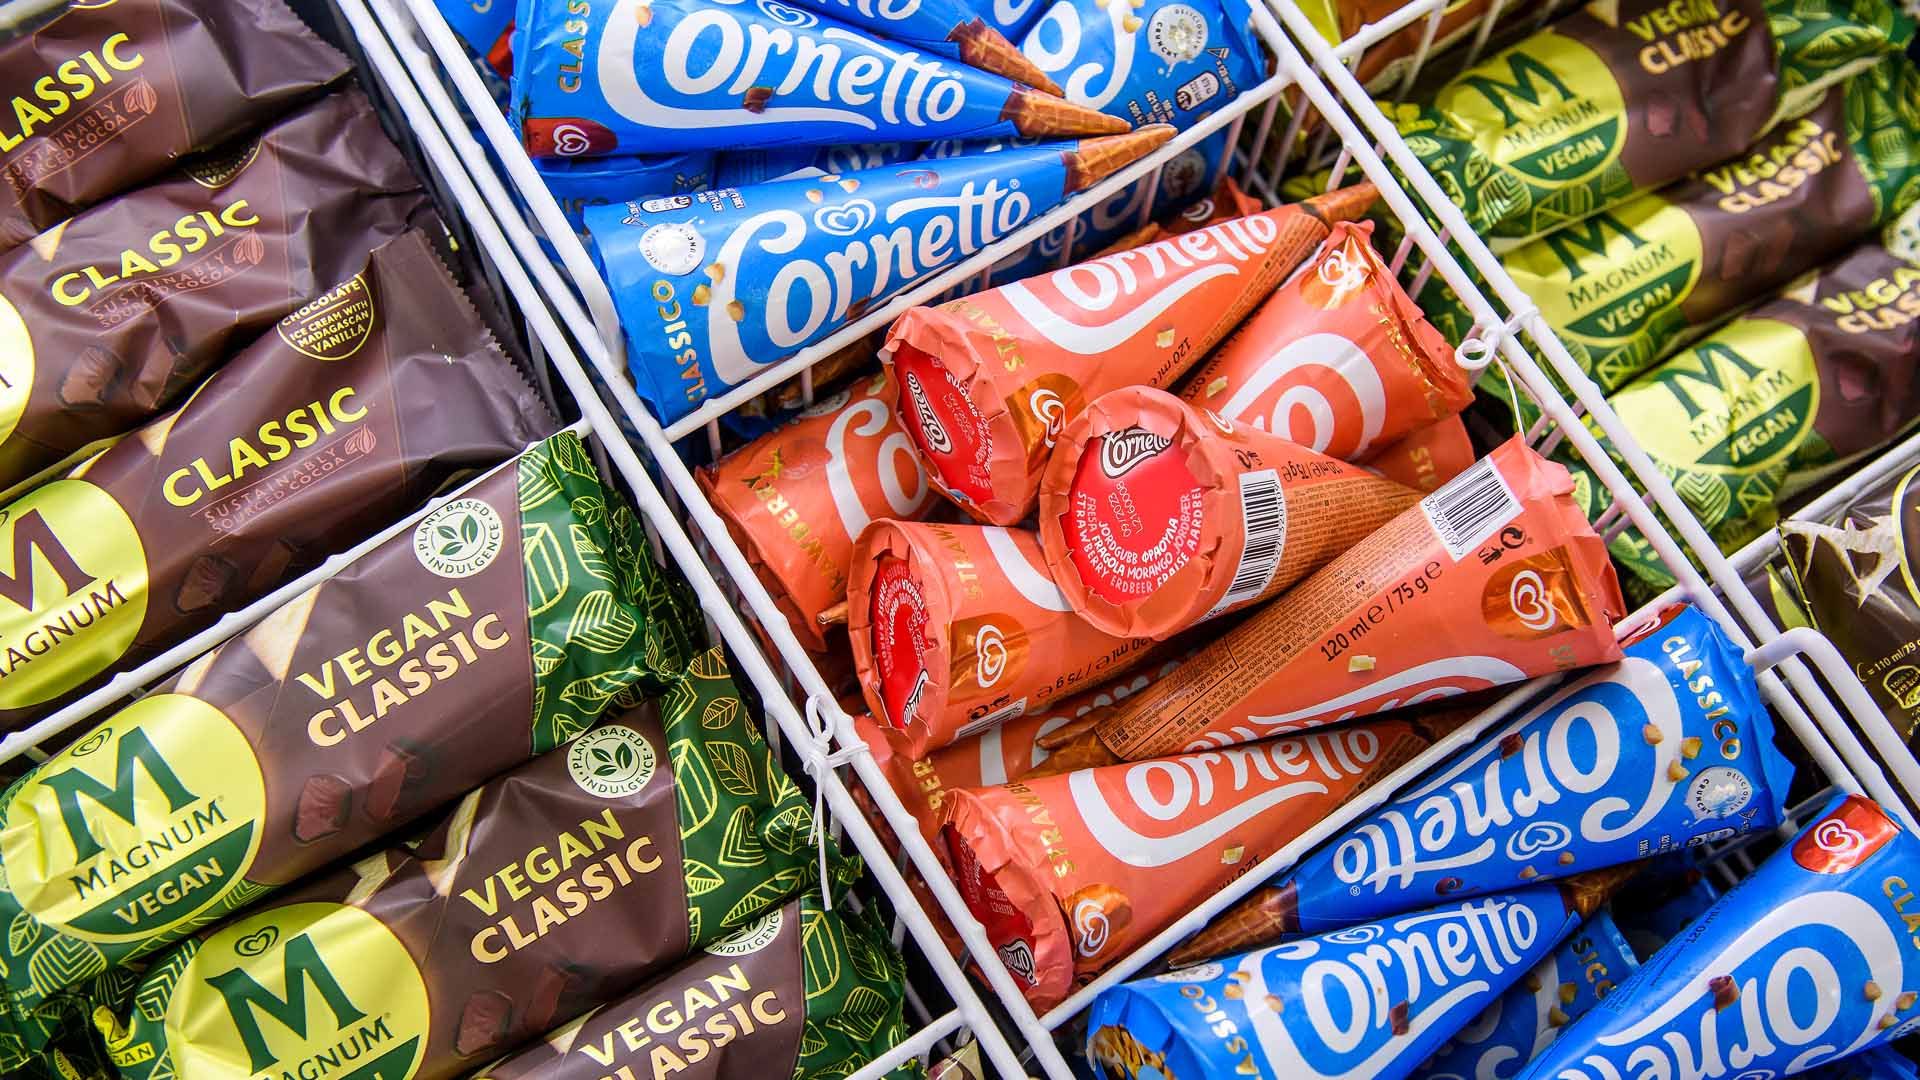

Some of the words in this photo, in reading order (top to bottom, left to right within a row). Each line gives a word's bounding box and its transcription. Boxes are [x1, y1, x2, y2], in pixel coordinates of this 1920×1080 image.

[557, 0, 591, 94] CLASS
[597, 0, 966, 131] Cornetto
[0, 33, 144, 152] LASSIC
[1508, 100, 1602, 150] MAGNUM
[78, 114, 127, 150] COCOA
[1537, 136, 1607, 176] VEGAN
[1704, 119, 1823, 196] VEGAN
[1718, 131, 1842, 214] CLASSIC
[52, 200, 260, 306] CLASSIC
[708, 178, 1031, 386] Cornetto
[1566, 243, 1676, 311] MAGNUM
[1823, 267, 1920, 313] VEGA
[281, 279, 361, 327] CHOCOLATE
[290, 327, 309, 341] ICE
[309, 313, 341, 333] CREAM
[342, 300, 368, 319] WITH
[298, 311, 369, 348] MADAGASCAN
[311, 324, 366, 353] VANILLA
[1597, 283, 1673, 333] VEGAN
[1691, 369, 1794, 444] MAGNUM
[1729, 408, 1799, 463] VEGAN
[162, 387, 369, 507] CLASSIC
[204, 447, 336, 524] SUSTAINABLY
[212, 490, 285, 534] SOURCED
[290, 456, 345, 490] COCOA
[418, 512, 442, 551] PLANT
[446, 501, 490, 517] BASED
[429, 522, 500, 574] INDULGENCE
[1076, 492, 1110, 578] STRAWBERRY
[1111, 576, 1153, 593] ERDBEER
[1187, 488, 1202, 551] AARDBEI
[1087, 496, 1097, 532] FRESA
[1092, 536, 1125, 576] FRAGOLA
[1127, 552, 1173, 580] MORANGO
[1098, 521, 1137, 564] JORDGUBB
[295, 587, 472, 699] VEGAN
[1320, 633, 1350, 661] 120
[1392, 583, 1415, 604] 75
[307, 613, 510, 747] CLASSIC
[1662, 635, 1742, 760] CLASSICO
[1875, 657, 1891, 672] 110
[572, 734, 596, 769] PLANT
[599, 727, 644, 747] BASED
[583, 752, 654, 794] INDULGENCE
[1333, 657, 1683, 894] Cornetto
[37, 726, 200, 865] M
[69, 800, 228, 900] MAGNUM
[459, 807, 625, 917] VEGAN
[113, 857, 224, 925] VEGAN
[471, 836, 663, 964] CLASSIC
[205, 932, 368, 1076] M
[577, 963, 750, 1067] VEGAN
[1238, 898, 1538, 1080] Cornetto
[264, 1016, 394, 1080] GNUM
[599, 991, 786, 1080] ASSIC
[1180, 984, 1260, 1076] ASSICO
